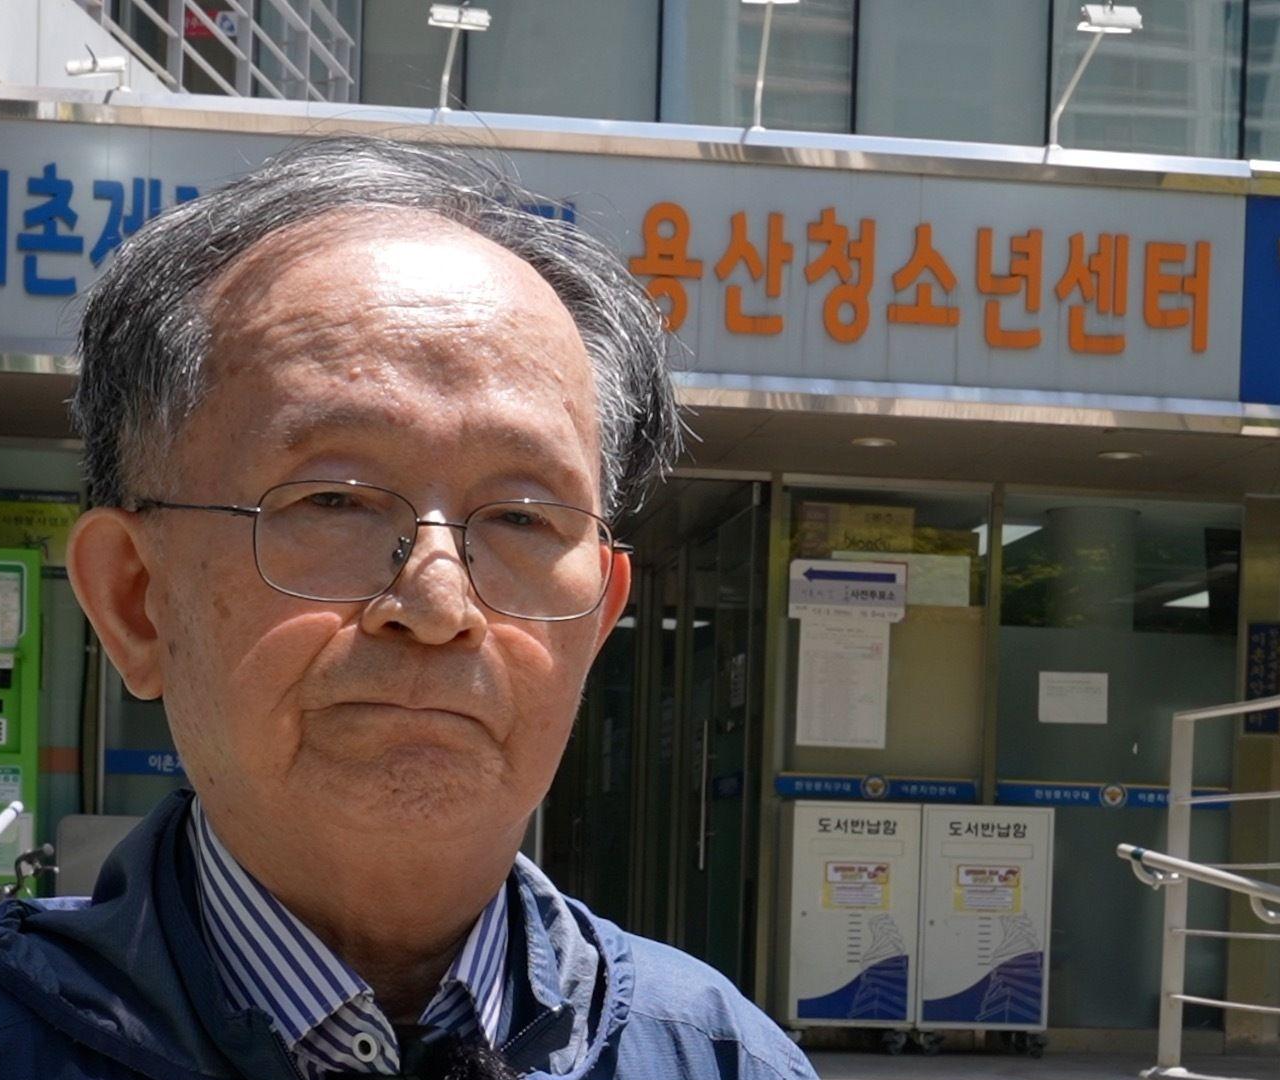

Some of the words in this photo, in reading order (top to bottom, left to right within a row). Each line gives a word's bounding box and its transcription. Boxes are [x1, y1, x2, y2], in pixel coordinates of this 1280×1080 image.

[628, 201, 1211, 355] 용산청소년센터
[817, 818, 898, 836] 도서반납함
[948, 821, 1028, 838] 도서반납함
